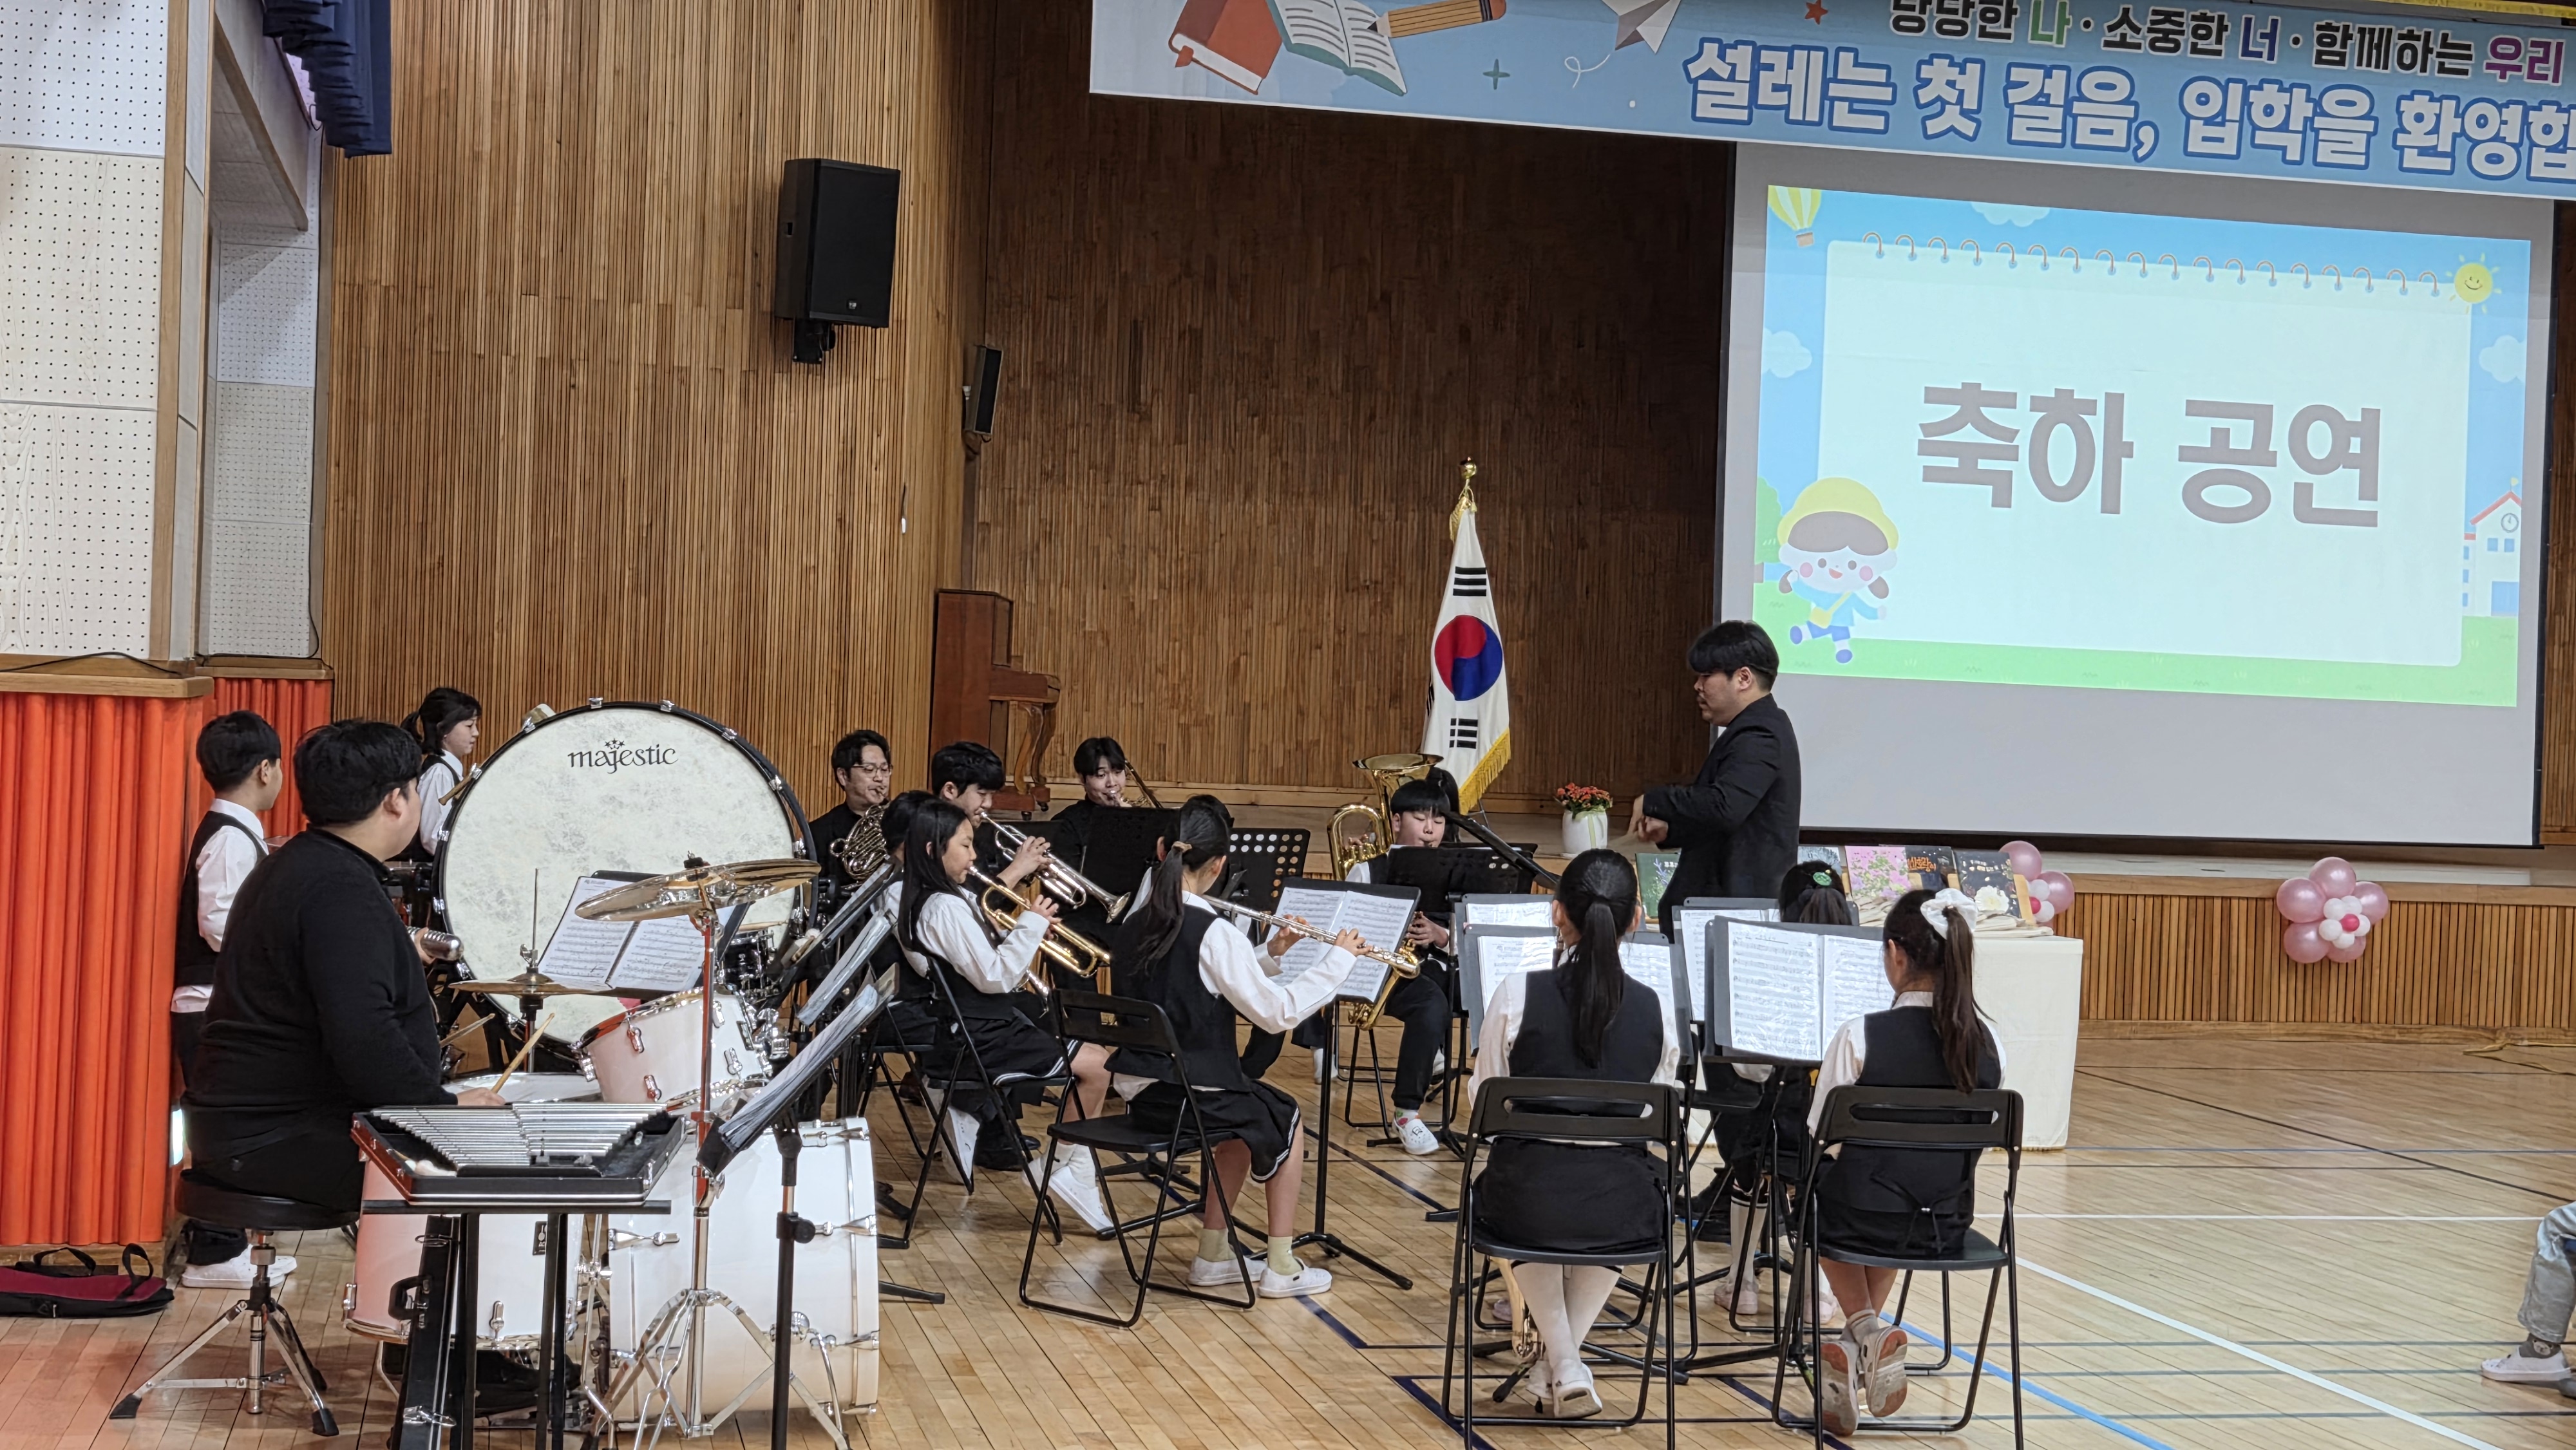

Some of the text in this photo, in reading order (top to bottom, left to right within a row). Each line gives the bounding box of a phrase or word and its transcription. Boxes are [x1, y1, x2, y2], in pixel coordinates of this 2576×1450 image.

[2102, 5, 2229, 58] 소중한
[2312, 21, 2474, 77] 함께하는
[2483, 36, 2564, 84] 우리
[1685, 41, 1895, 131] 설레는
[1915, 56, 1984, 139] 첫
[2005, 65, 2157, 160] 걸음,
[2181, 78, 2377, 167] 입학을
[1916, 381, 2382, 528] 축하 공연
[567, 743, 679, 775] majestic
